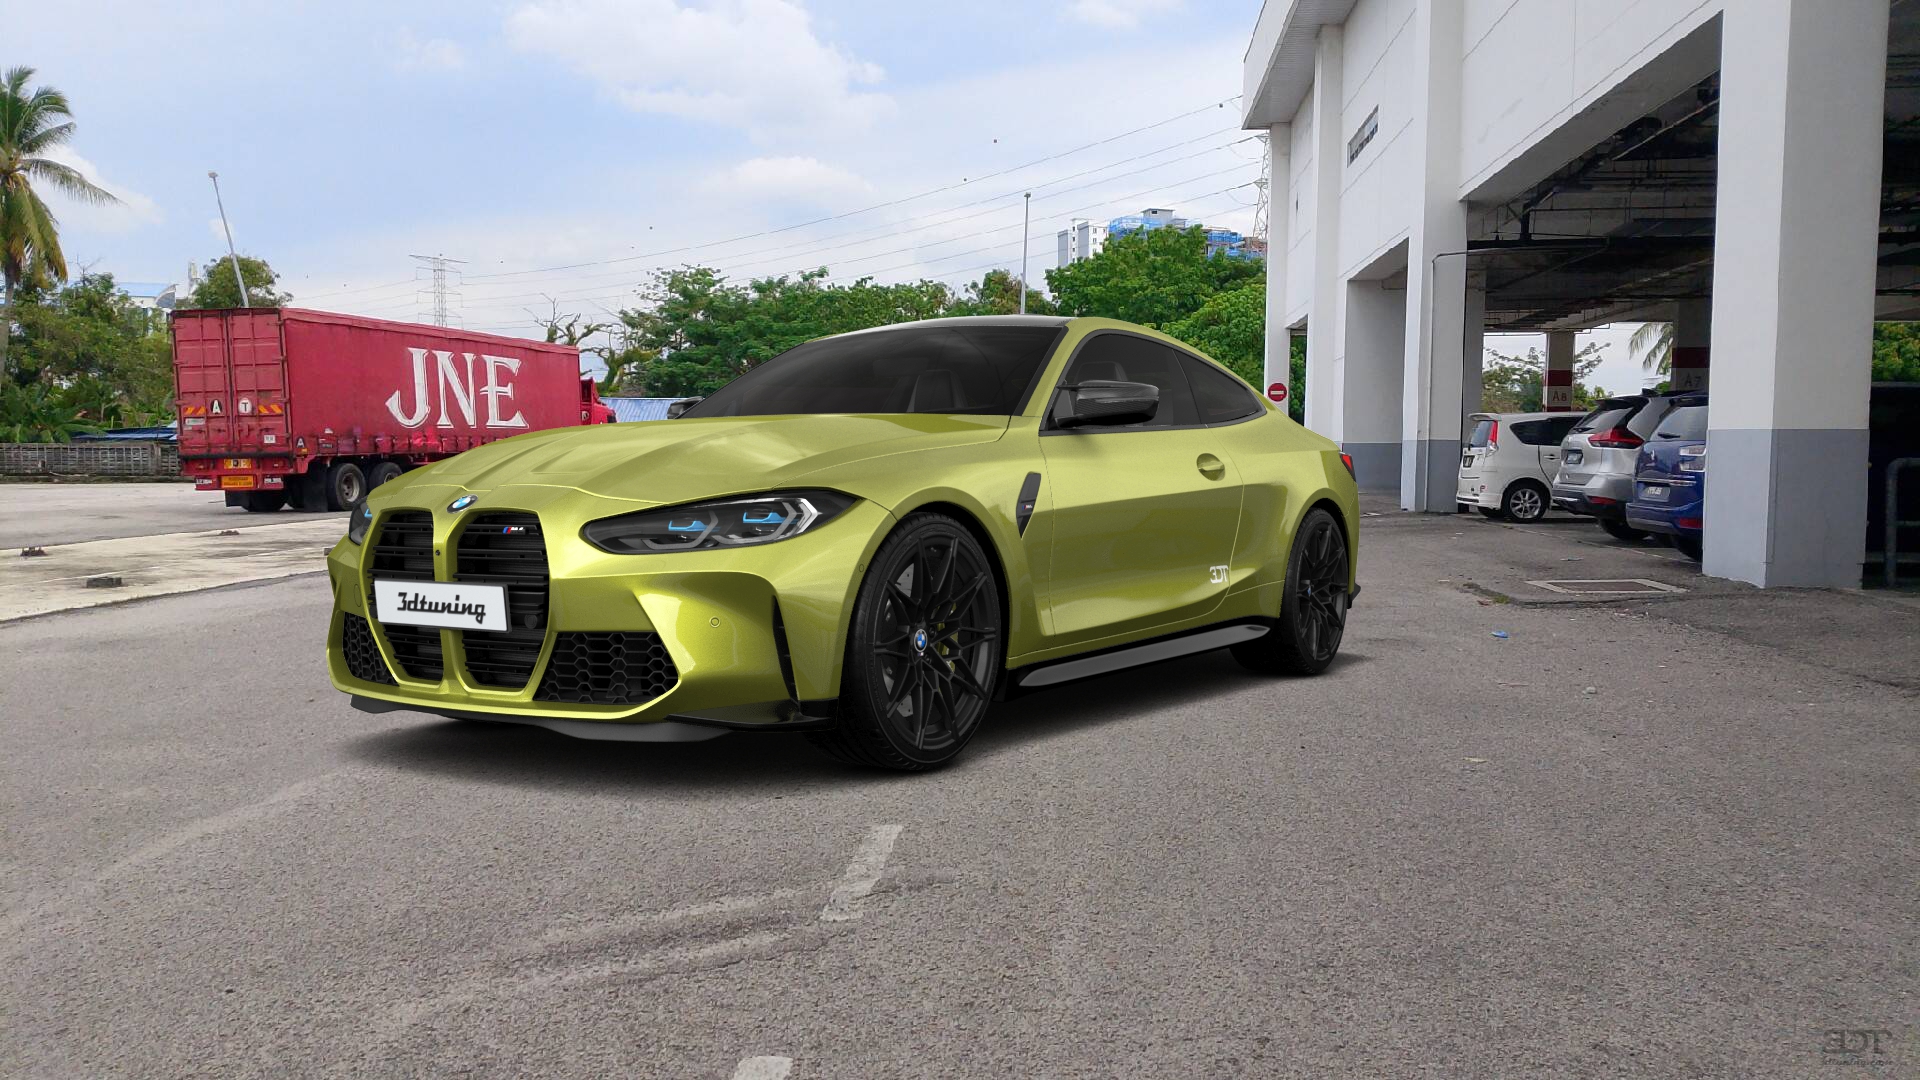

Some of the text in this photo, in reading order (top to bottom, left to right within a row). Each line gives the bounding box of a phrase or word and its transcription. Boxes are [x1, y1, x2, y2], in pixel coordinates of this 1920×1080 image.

[385, 348, 529, 429] JNE
[212, 399, 221, 414] A
[397, 592, 486, 624] 3dtuning
